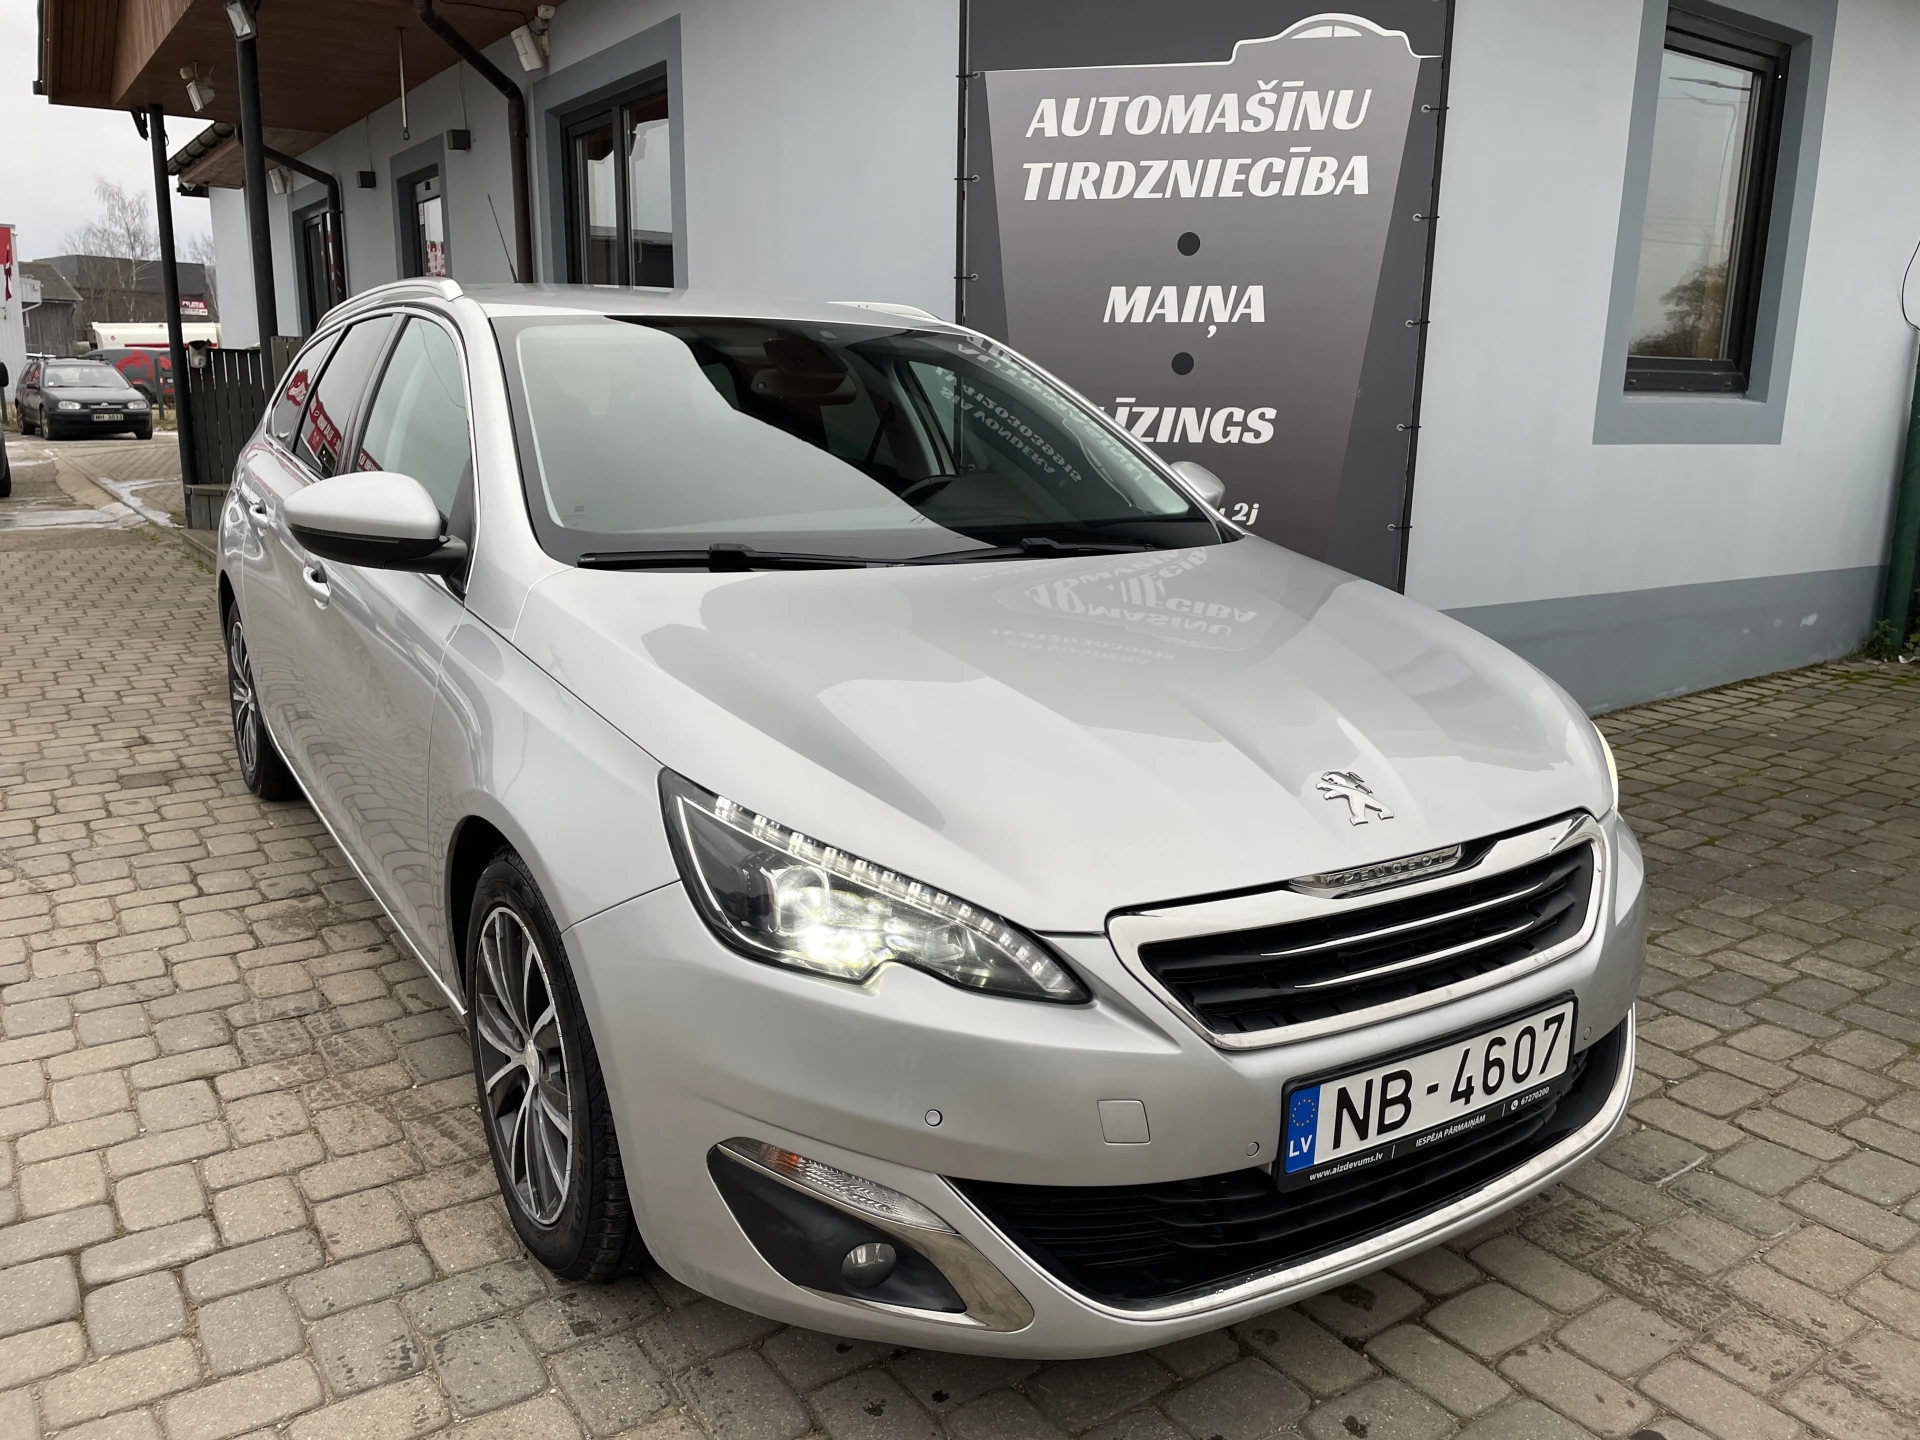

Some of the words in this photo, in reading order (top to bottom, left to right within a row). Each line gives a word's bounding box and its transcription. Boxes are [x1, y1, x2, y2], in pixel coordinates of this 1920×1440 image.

[1025, 79, 1373, 138] AUTOMAŠĪNU
[1022, 146, 1370, 201] TIRDZNIECĪBA
[1103, 285, 1266, 338] MAIŅA
[1098, 397, 1277, 444] ĪZINGS
[1343, 851, 1446, 885] PEUGEOT
[1289, 1134, 1313, 1158] LV
[1309, 1152, 1384, 1181] www.aizdevums.lv
[1520, 1086, 1550, 1106] 67270200
